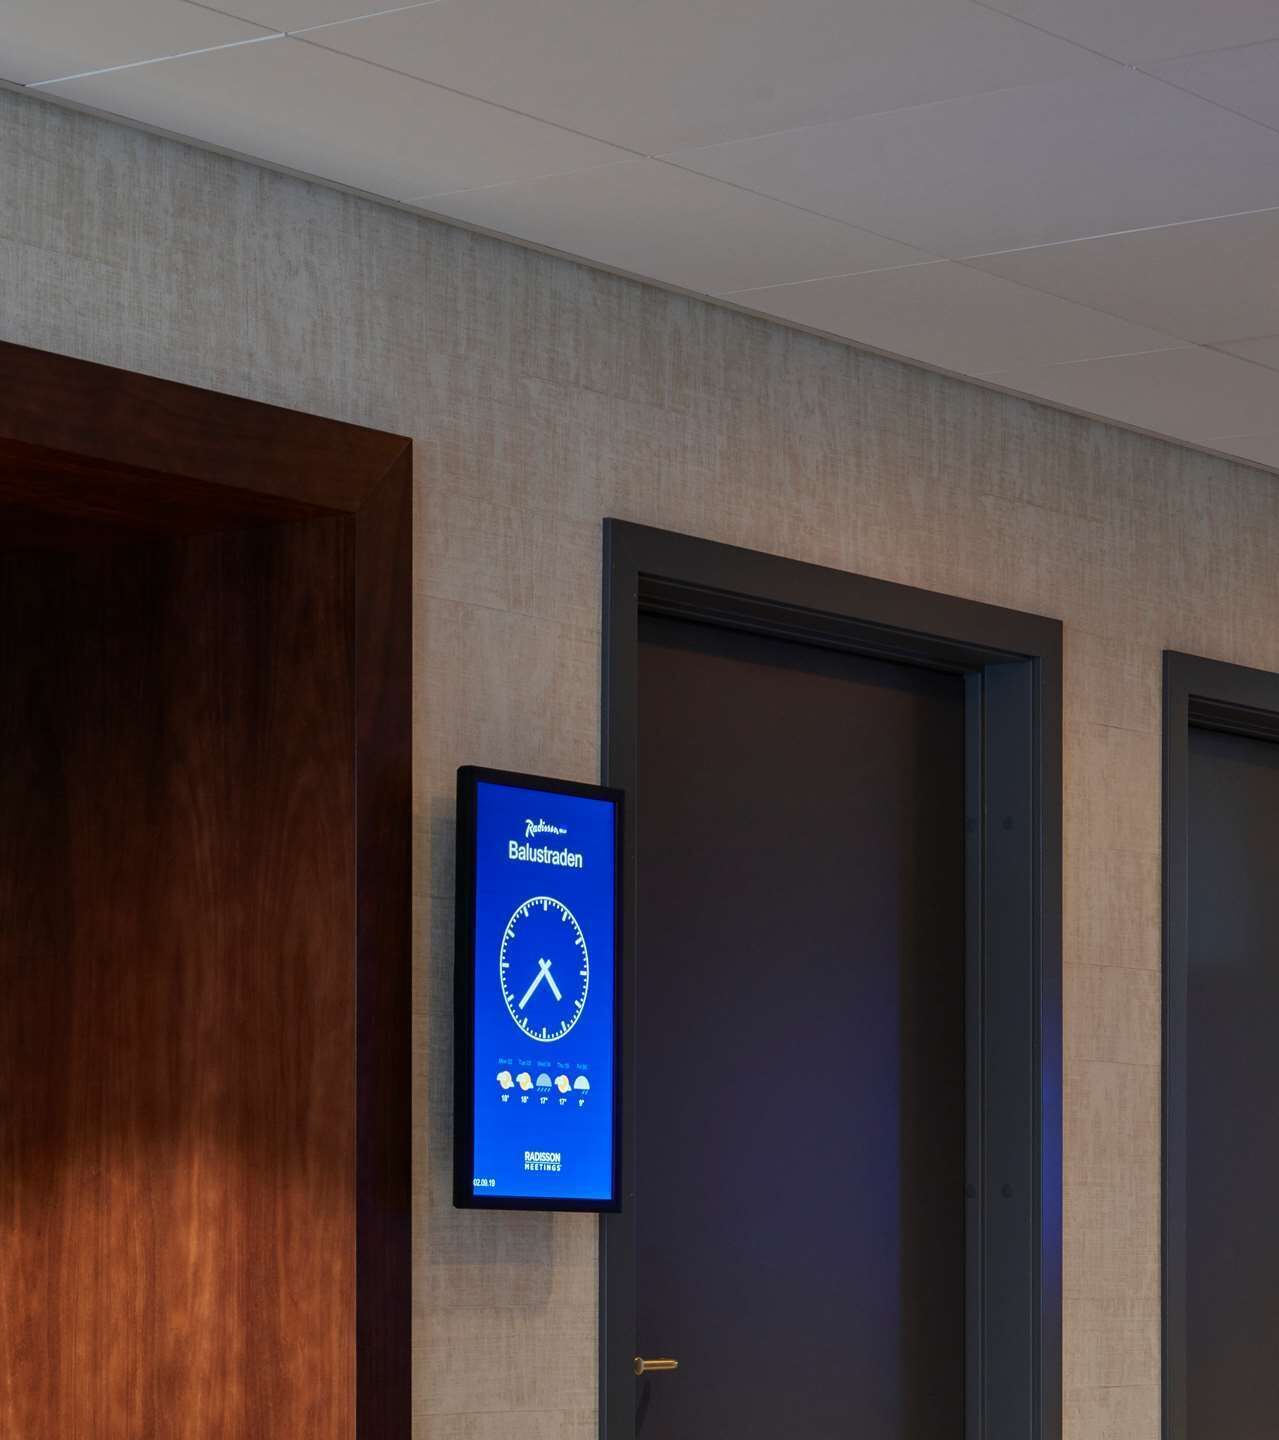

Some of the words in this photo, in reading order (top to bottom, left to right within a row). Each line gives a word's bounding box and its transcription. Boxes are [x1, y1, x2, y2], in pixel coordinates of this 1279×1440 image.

[508, 839, 583, 869] Balustraden
[524, 1151, 561, 1163] RADISSON
[524, 1163, 561, 1172] MEETINGS
